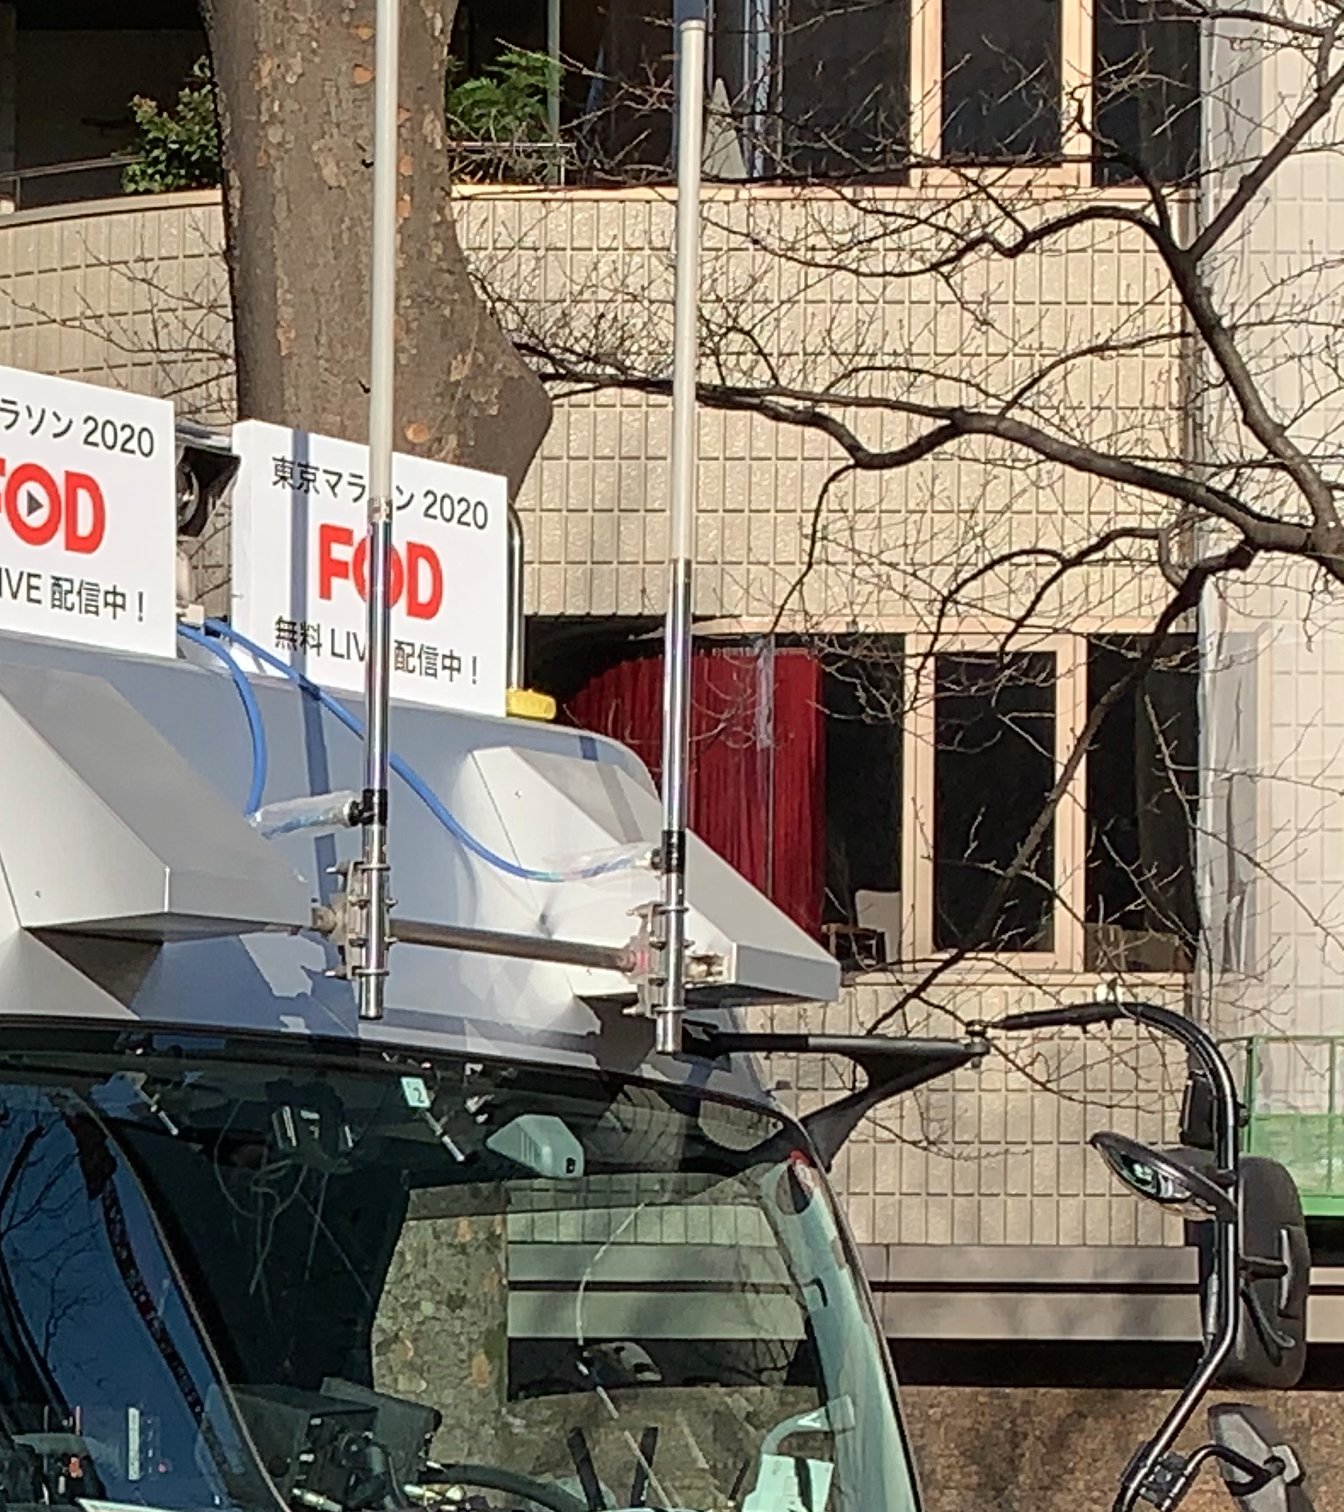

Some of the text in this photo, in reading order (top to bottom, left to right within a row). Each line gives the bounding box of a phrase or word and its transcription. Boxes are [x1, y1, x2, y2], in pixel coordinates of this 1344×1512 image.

[82, 415, 155, 458] 2020
[270, 456, 489, 531] 東京マラン 2020
[318, 523, 444, 621] FOD
[274, 616, 324, 657] 無料
[330, 628, 368, 662] LIV
